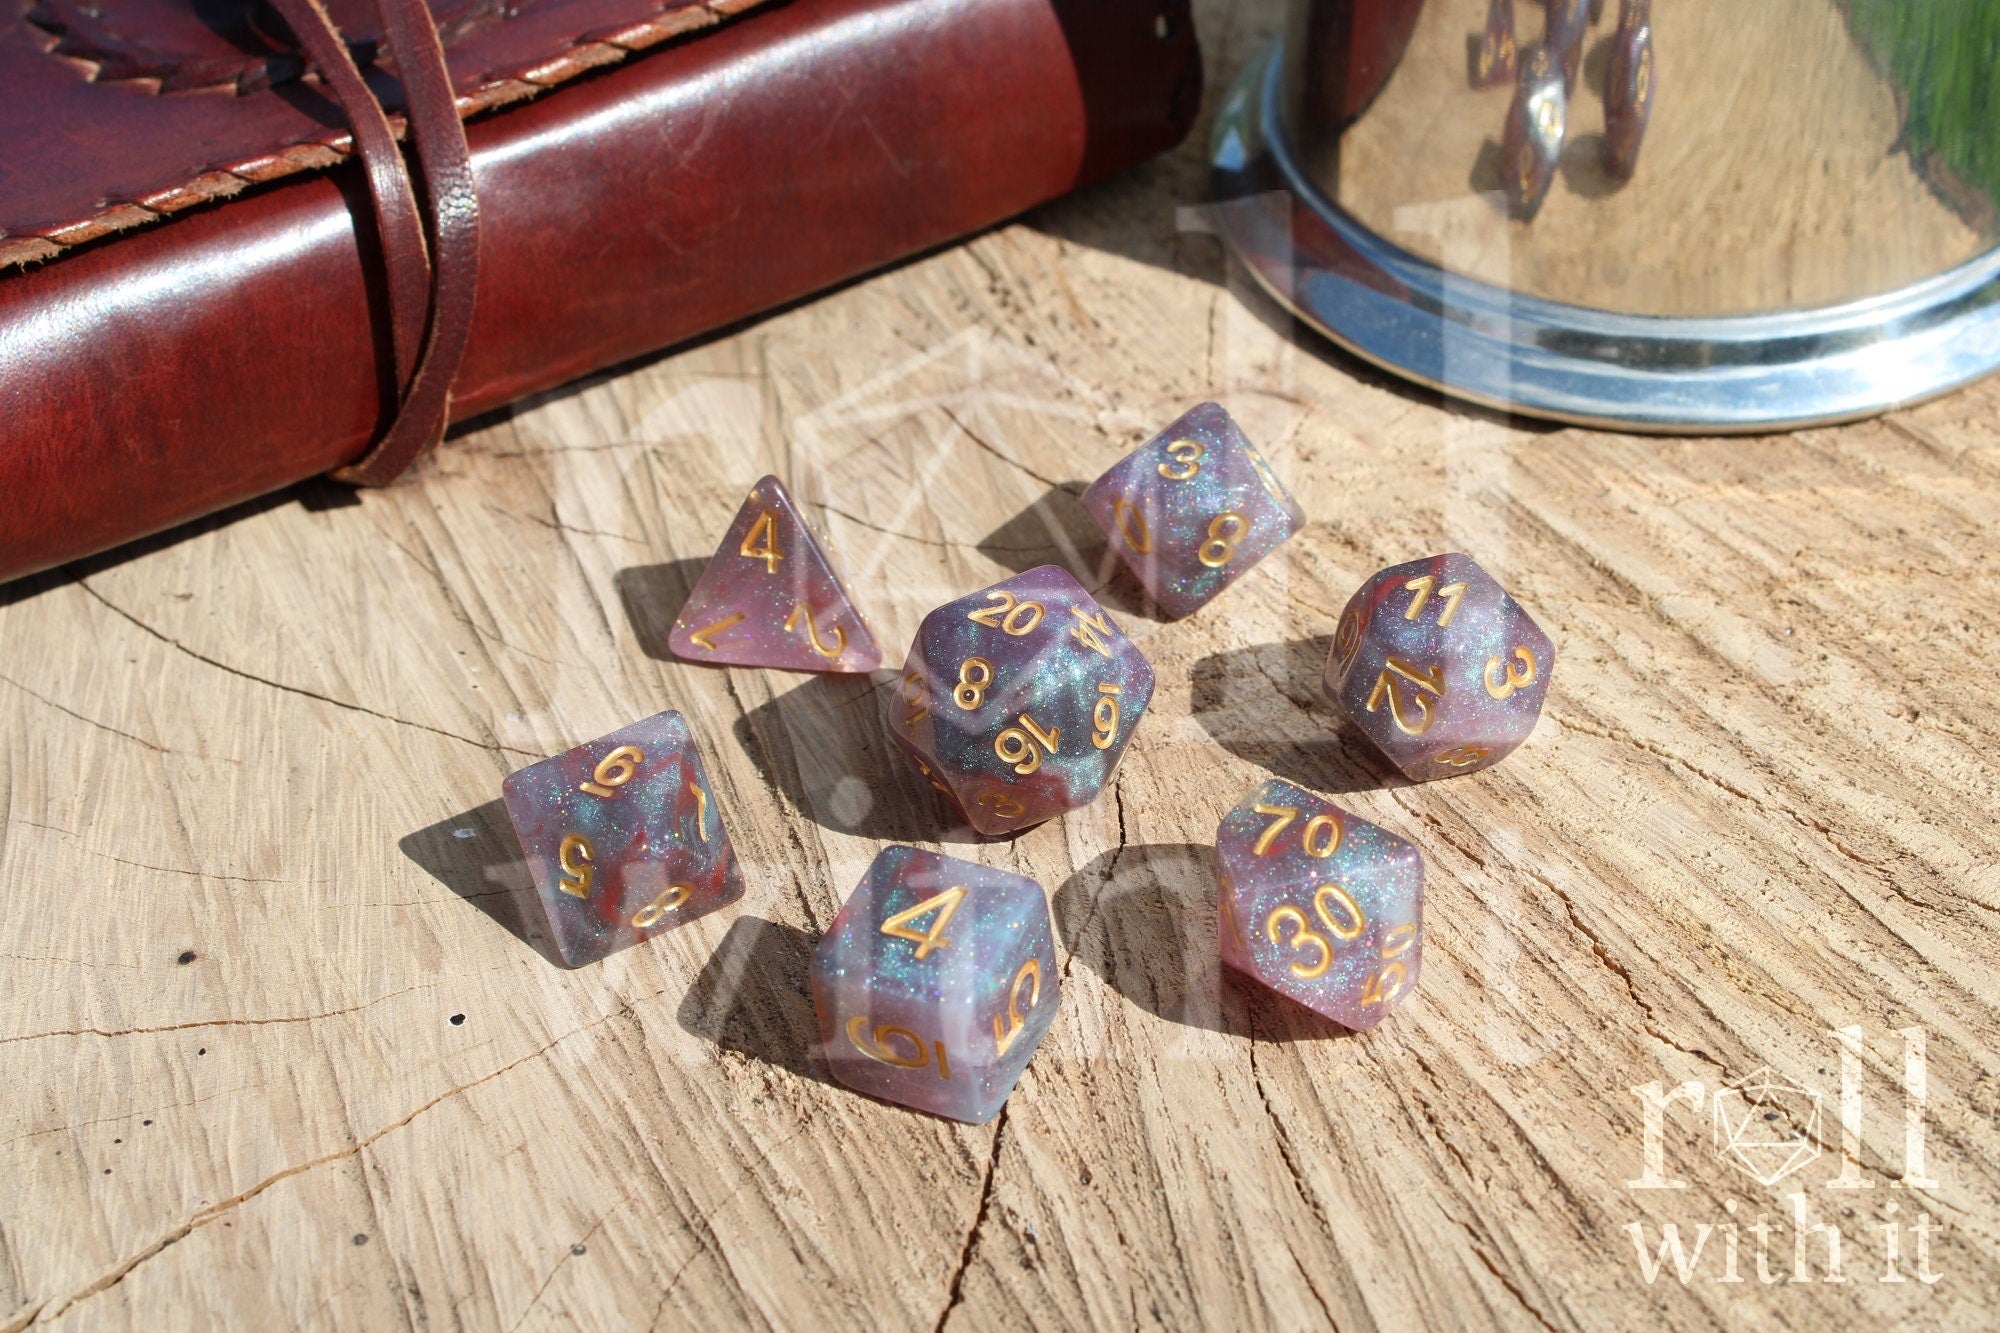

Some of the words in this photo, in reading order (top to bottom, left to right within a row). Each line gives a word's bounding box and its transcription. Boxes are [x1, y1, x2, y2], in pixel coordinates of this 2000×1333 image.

[1157, 439, 1205, 480] 3
[740, 509, 785, 574] 4
[1113, 498, 1152, 556] 0
[1198, 512, 1251, 568] 8
[967, 590, 1046, 636] 20
[1405, 575, 1470, 627] 11
[689, 611, 746, 651] 1
[783, 602, 848, 658] 2
[953, 656, 995, 711] 8
[1366, 656, 1447, 737] 12
[1484, 646, 1538, 700] 3
[994, 713, 1061, 775] 16
[1253, 803, 1345, 859] 70
[558, 832, 596, 899] 5
[631, 882, 694, 928] 8
[880, 885, 969, 960] 4
[1267, 883, 1366, 980] 30
[1360, 922, 1418, 1008] 50
[993, 957, 1042, 1058] 5
